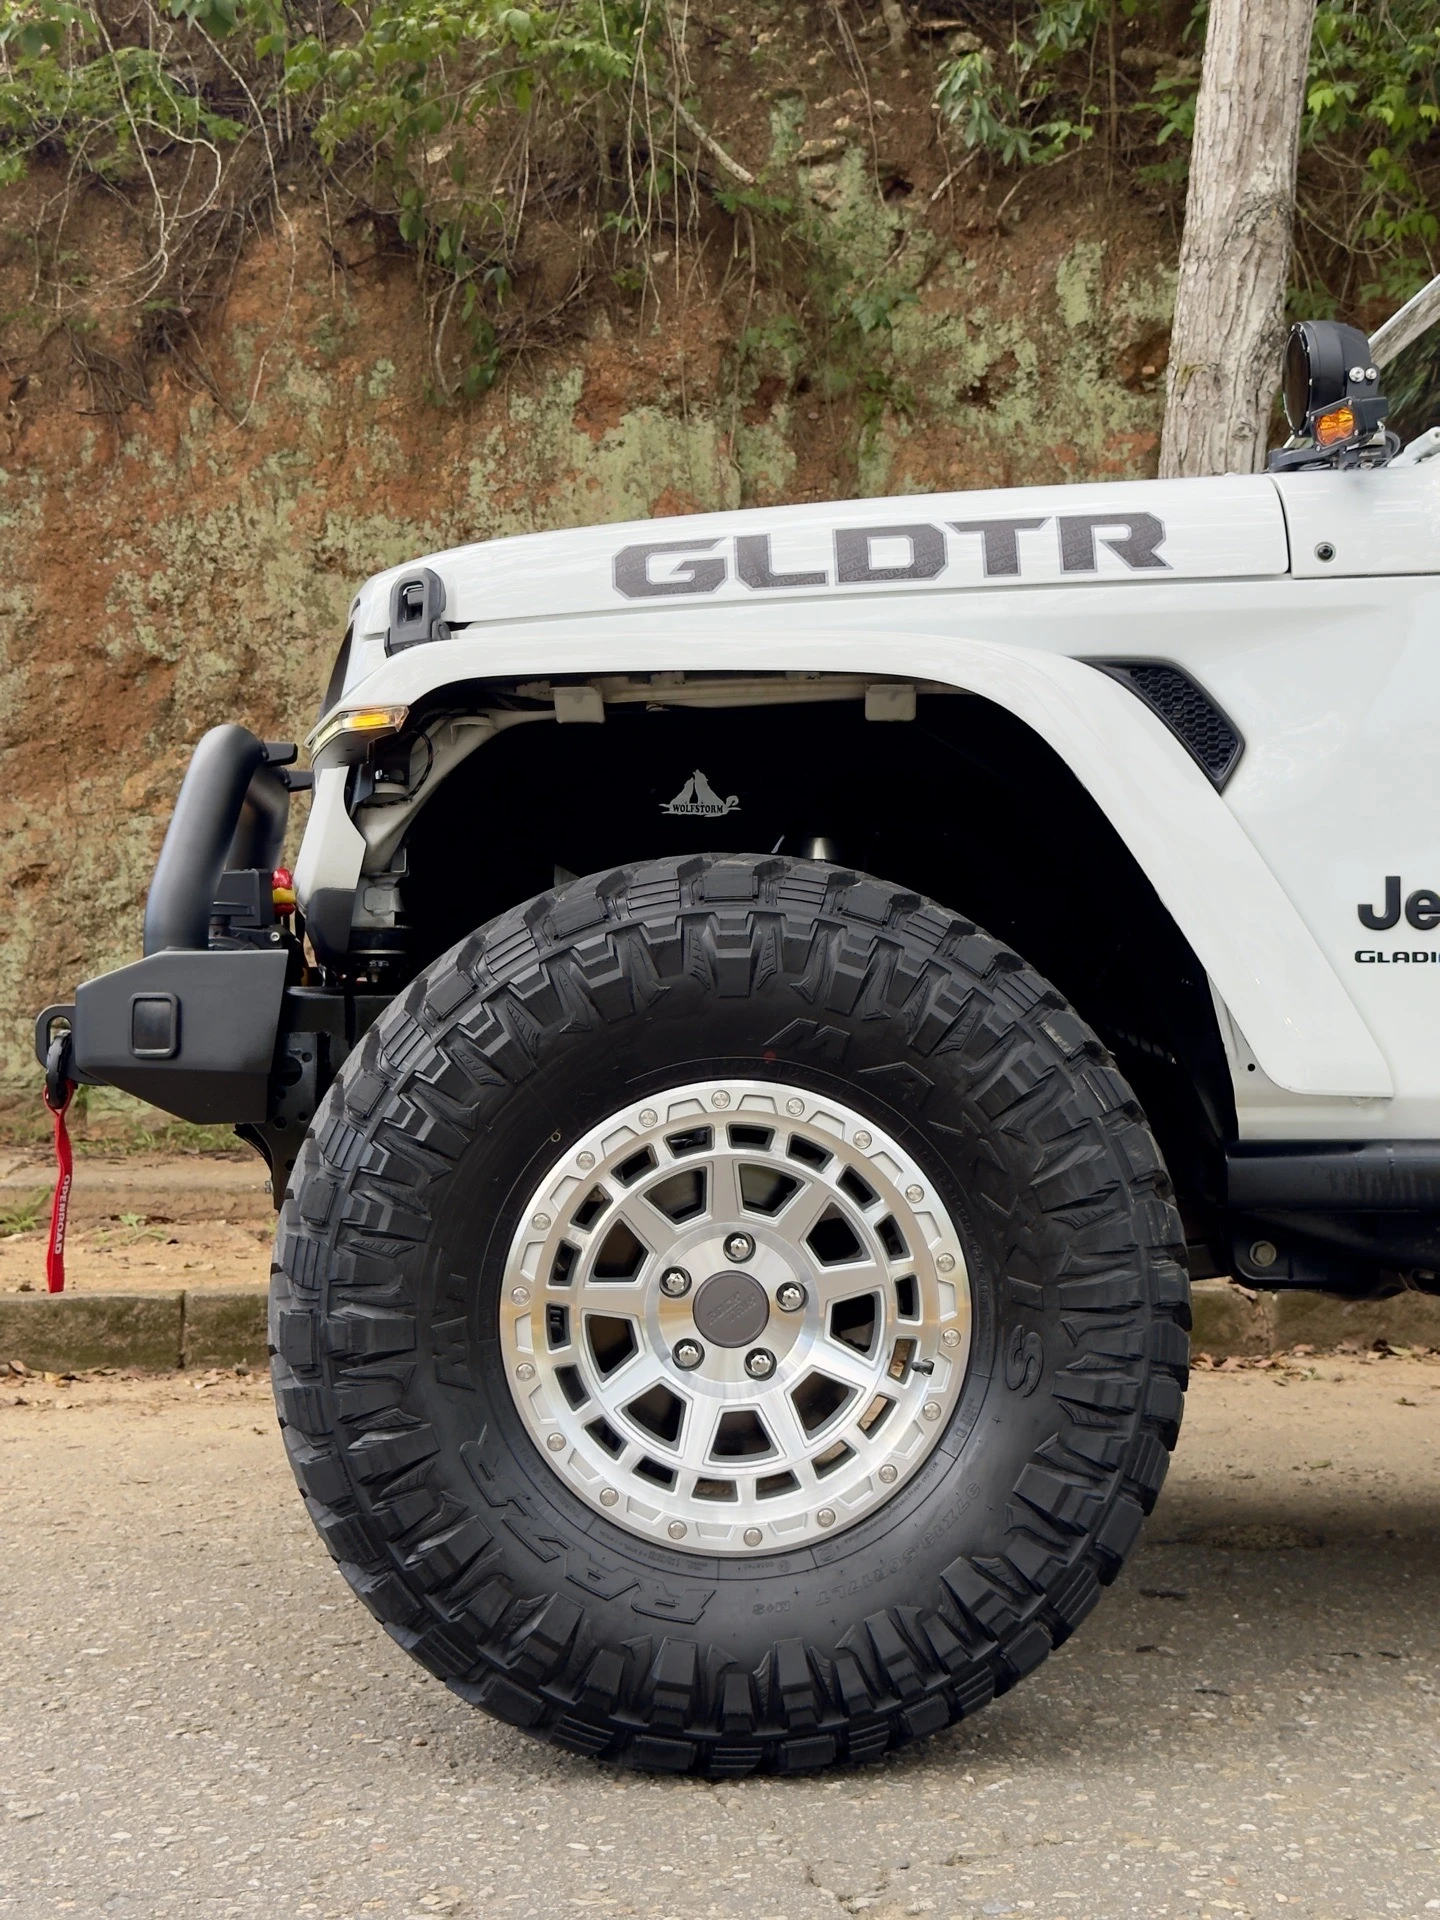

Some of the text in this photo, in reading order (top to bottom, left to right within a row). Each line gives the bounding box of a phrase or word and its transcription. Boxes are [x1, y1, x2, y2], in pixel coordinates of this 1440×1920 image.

[612, 512, 1173, 599] GLDTR
[672, 803, 724, 814] WOLFSTORM
[1357, 876, 1440, 931] Je
[1354, 950, 1440, 963] GLADI
[55, 1174, 70, 1255] OPENROAD
